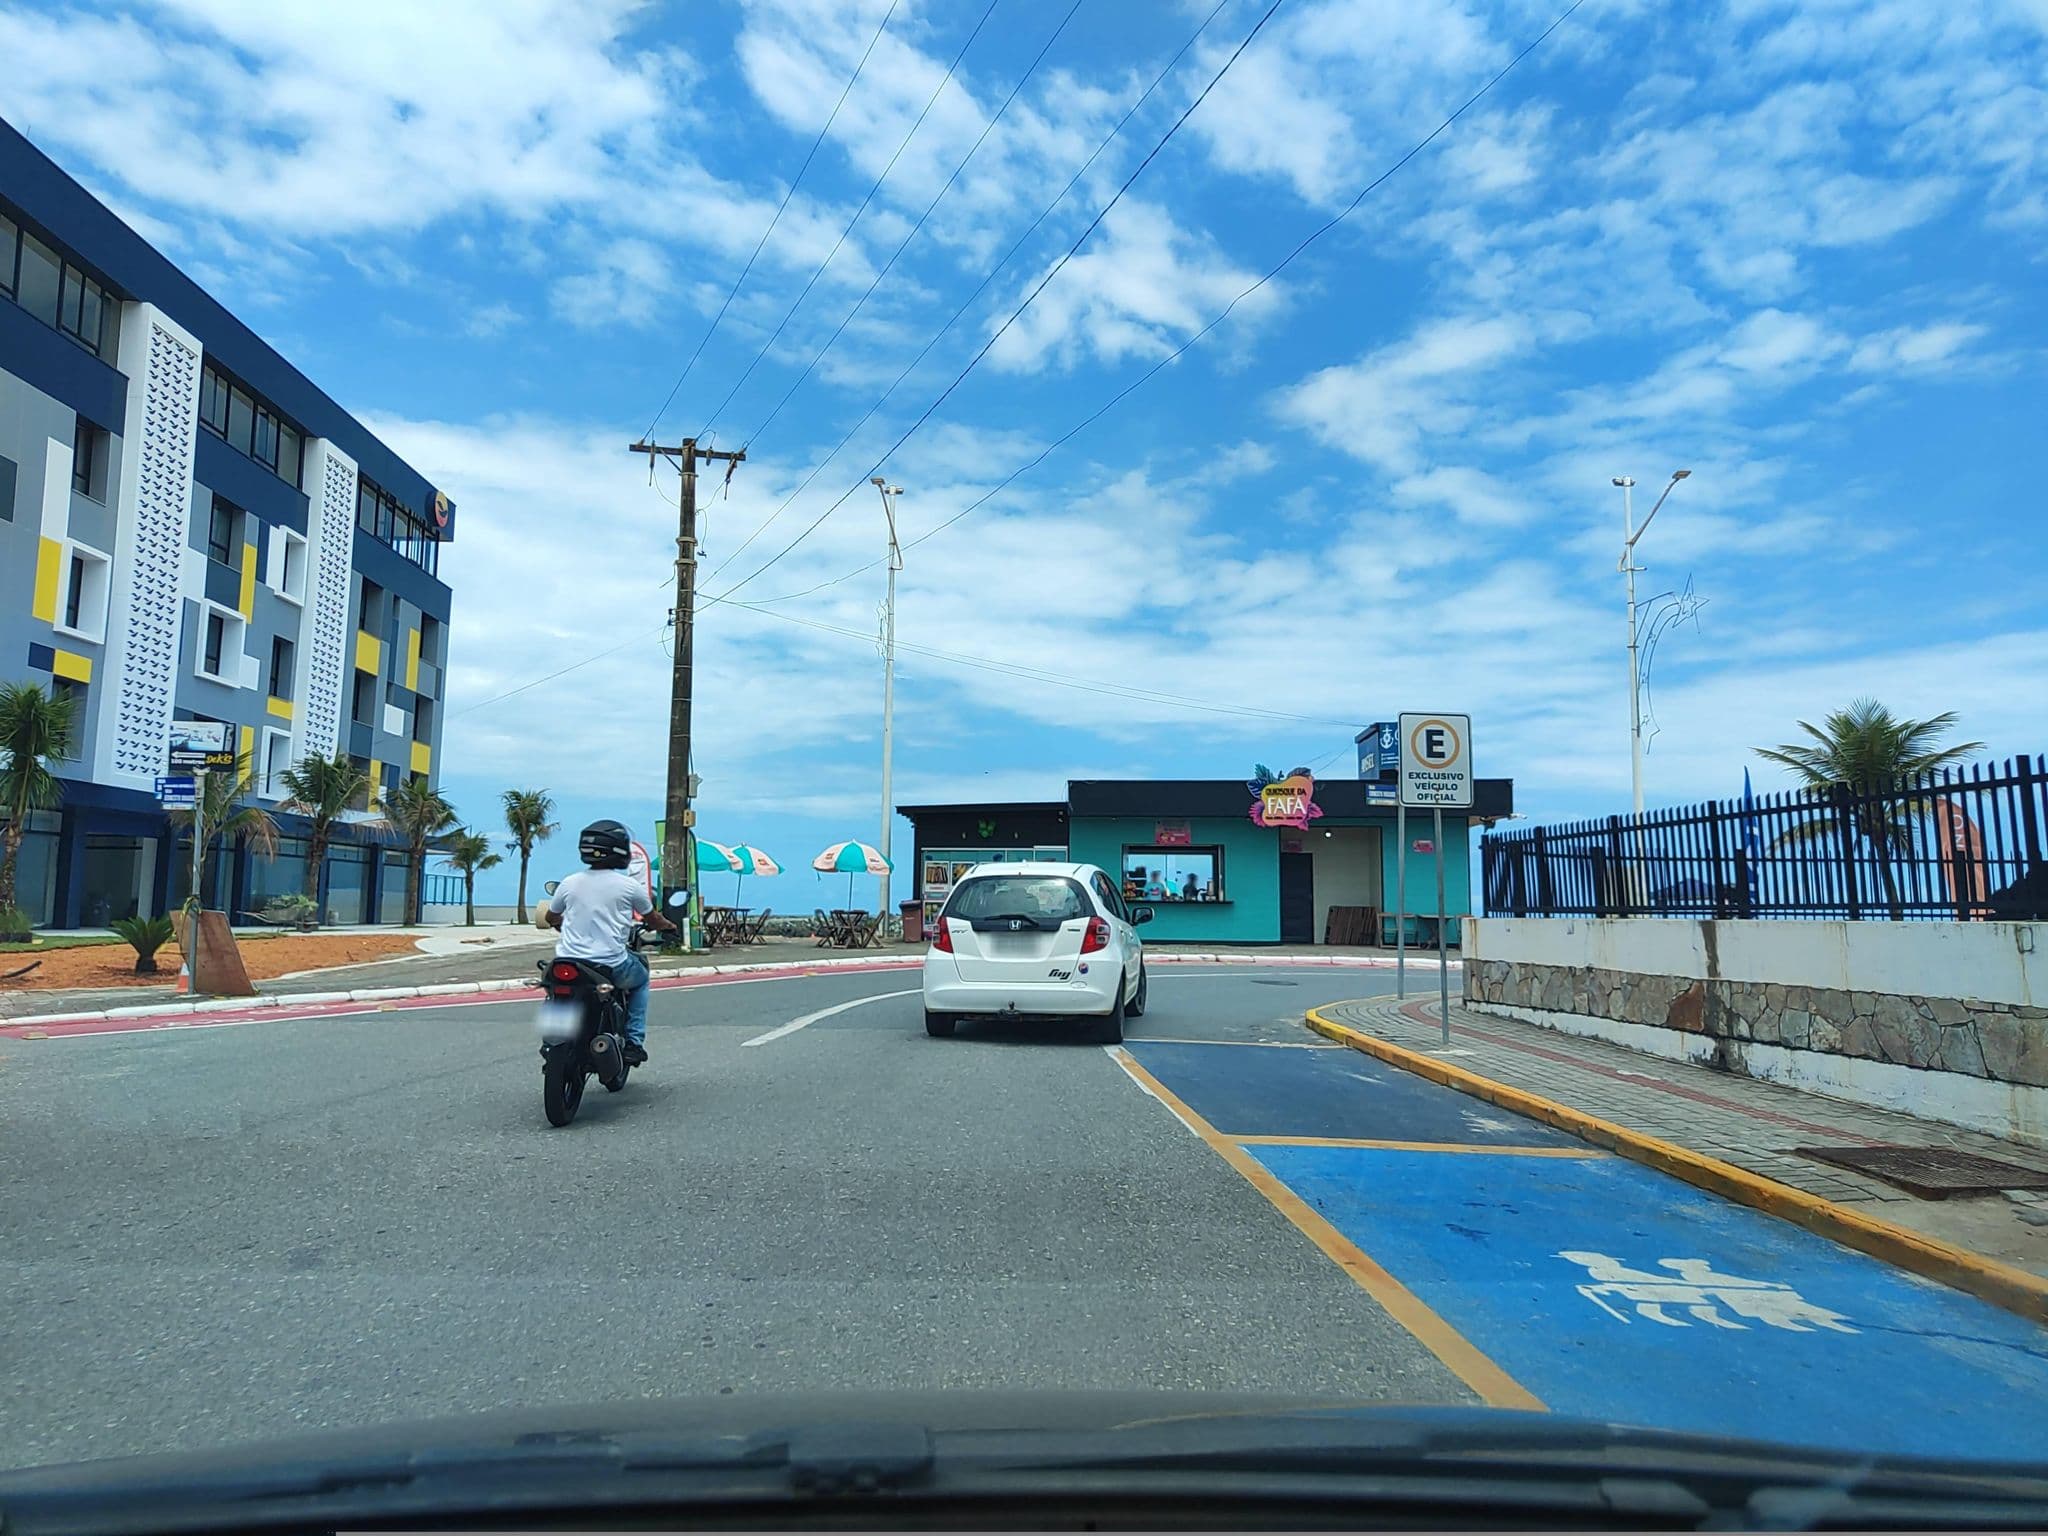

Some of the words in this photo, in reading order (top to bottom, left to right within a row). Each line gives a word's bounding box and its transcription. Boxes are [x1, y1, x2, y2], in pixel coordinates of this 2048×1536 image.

[1425, 729, 1446, 759] E
[1408, 771, 1464, 781] EXCLUSIVO
[1414, 781, 1459, 791] VEÍCULO
[1416, 793, 1457, 802] OFICIAL
